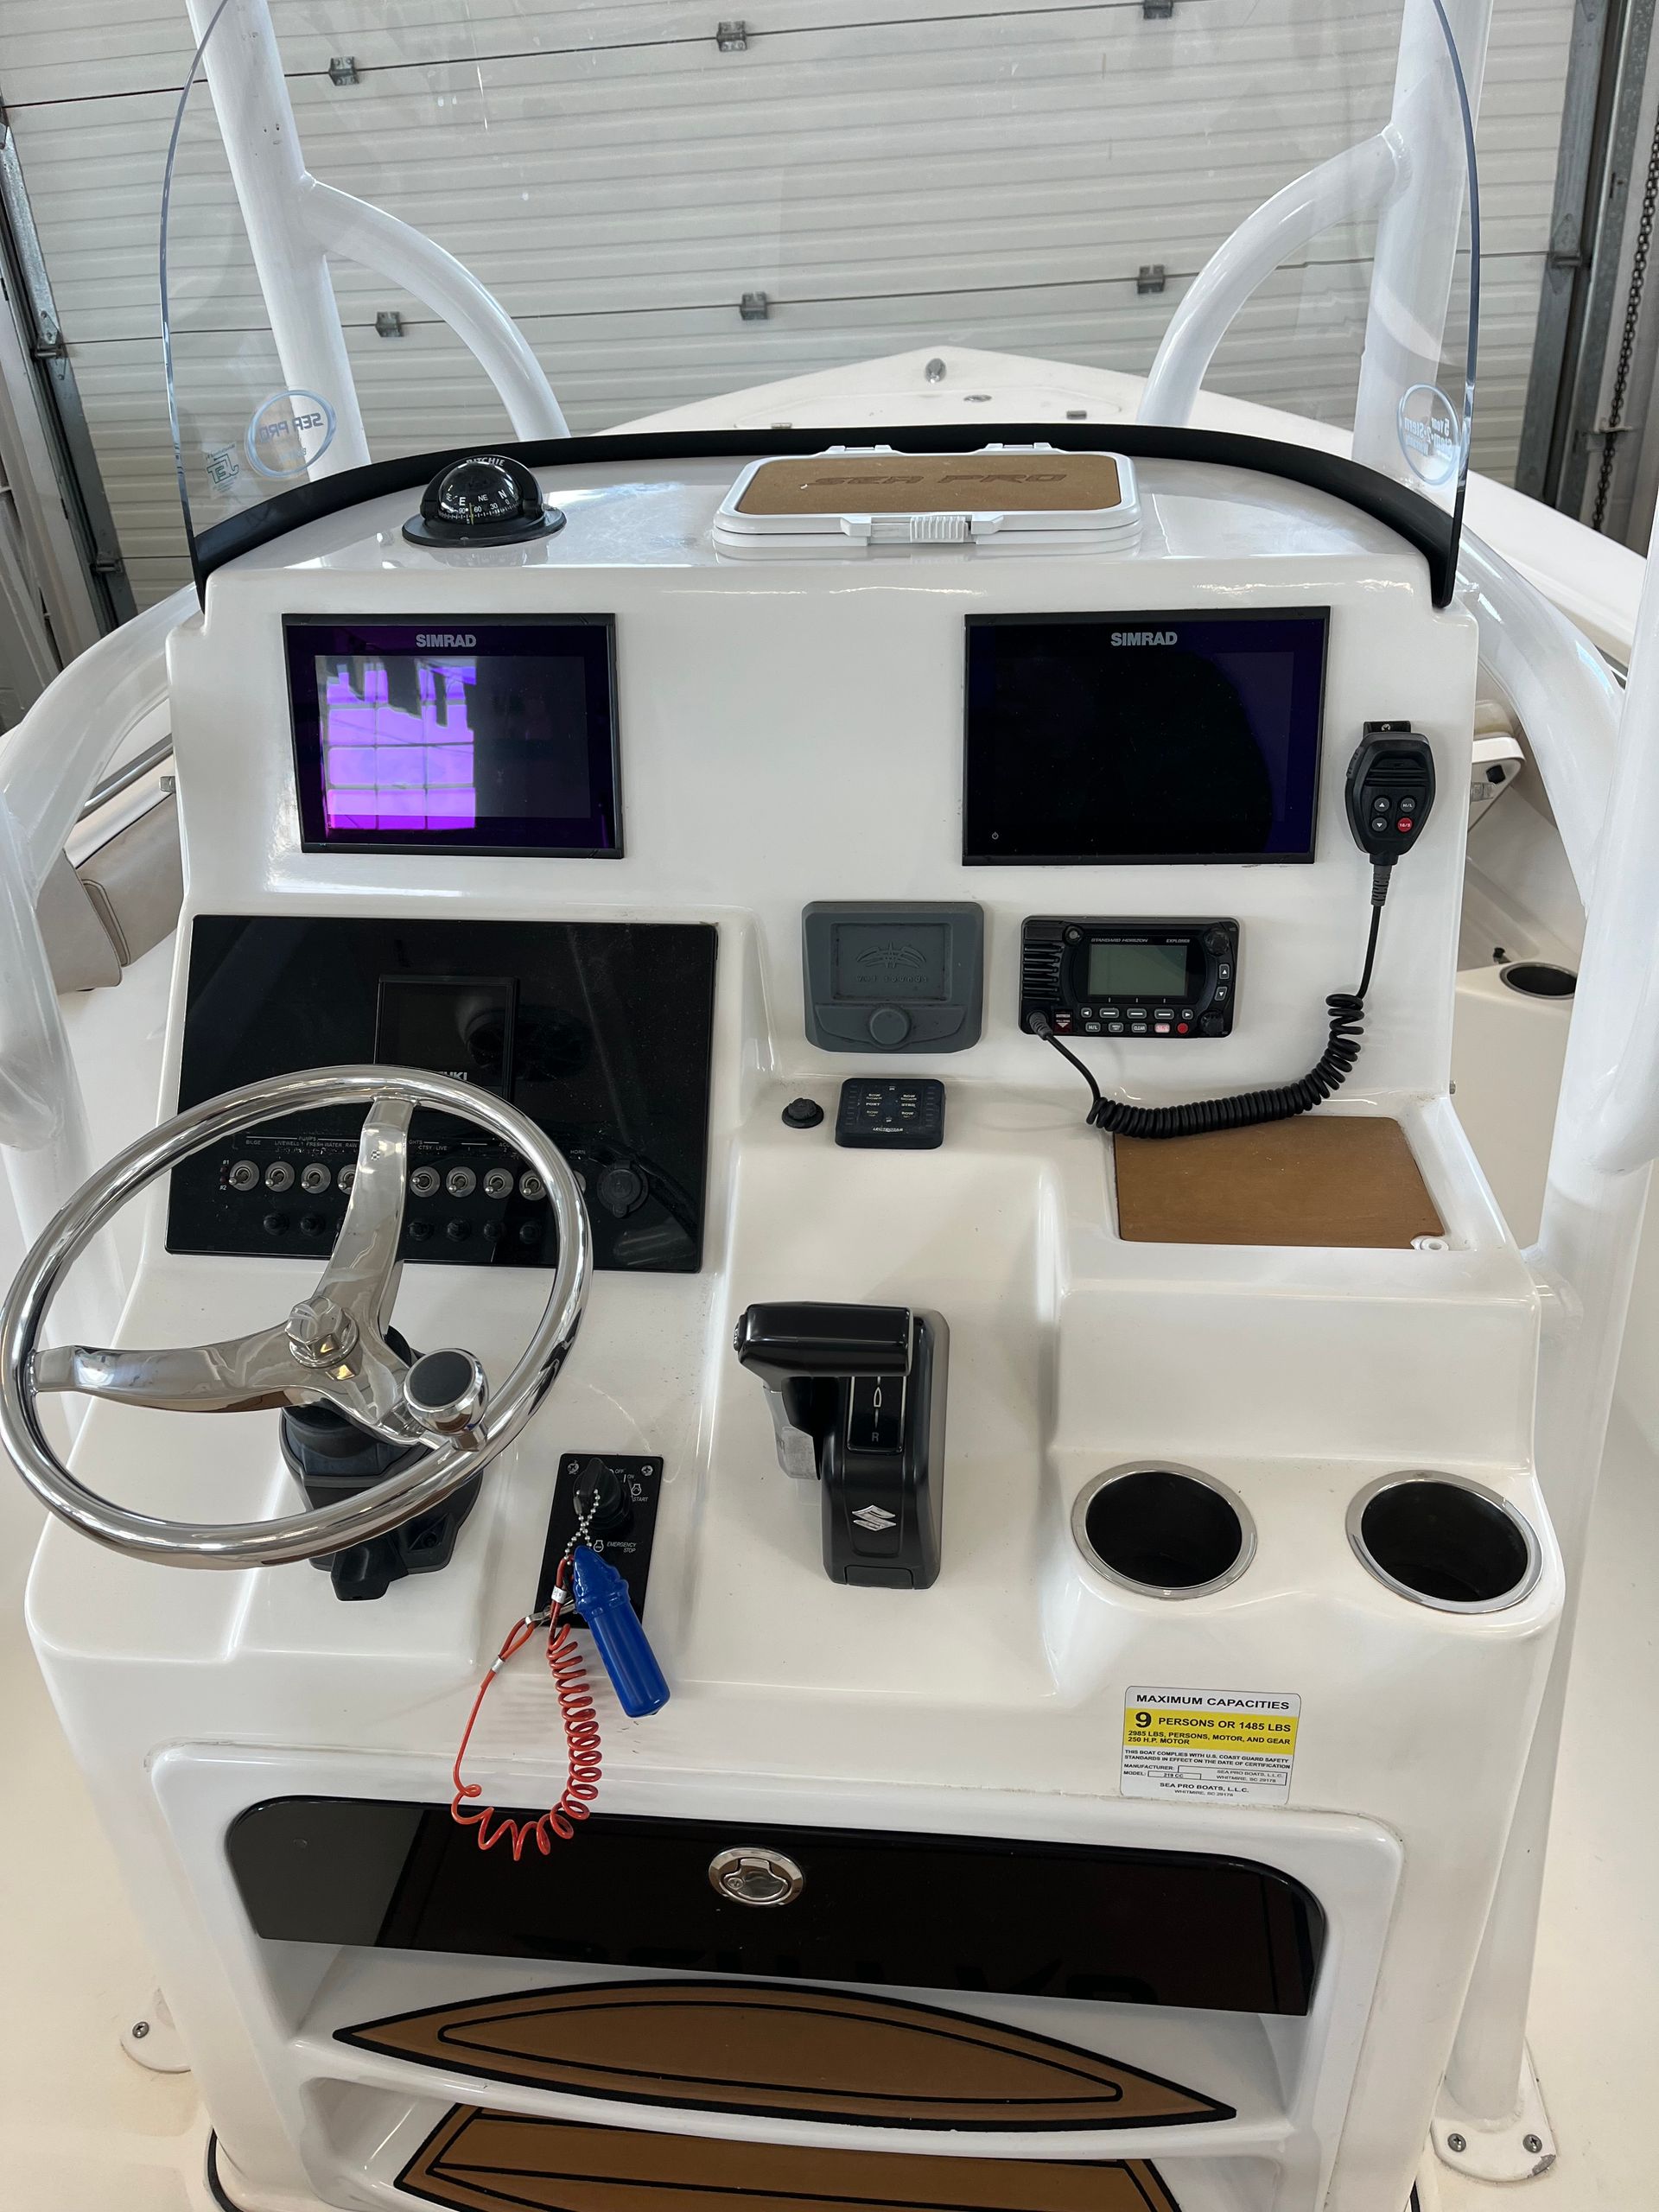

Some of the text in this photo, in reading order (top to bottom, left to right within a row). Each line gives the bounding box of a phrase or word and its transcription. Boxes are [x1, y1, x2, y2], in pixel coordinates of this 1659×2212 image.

[807, 474, 1067, 485] SEA PRO
[498, 489, 507, 499] N
[459, 497, 466, 505] E
[416, 634, 476, 647] SIMRAD
[1110, 632, 1178, 646] SIMRAD
[871, 1432, 880, 1442] R
[1136, 1694, 1290, 1710] MAXIMUM CAPACITIES
[1135, 1712, 1291, 1732] 9 PERSONS OR 1485 LBS
[1168, 1732, 1210, 1740] PERSONS,
